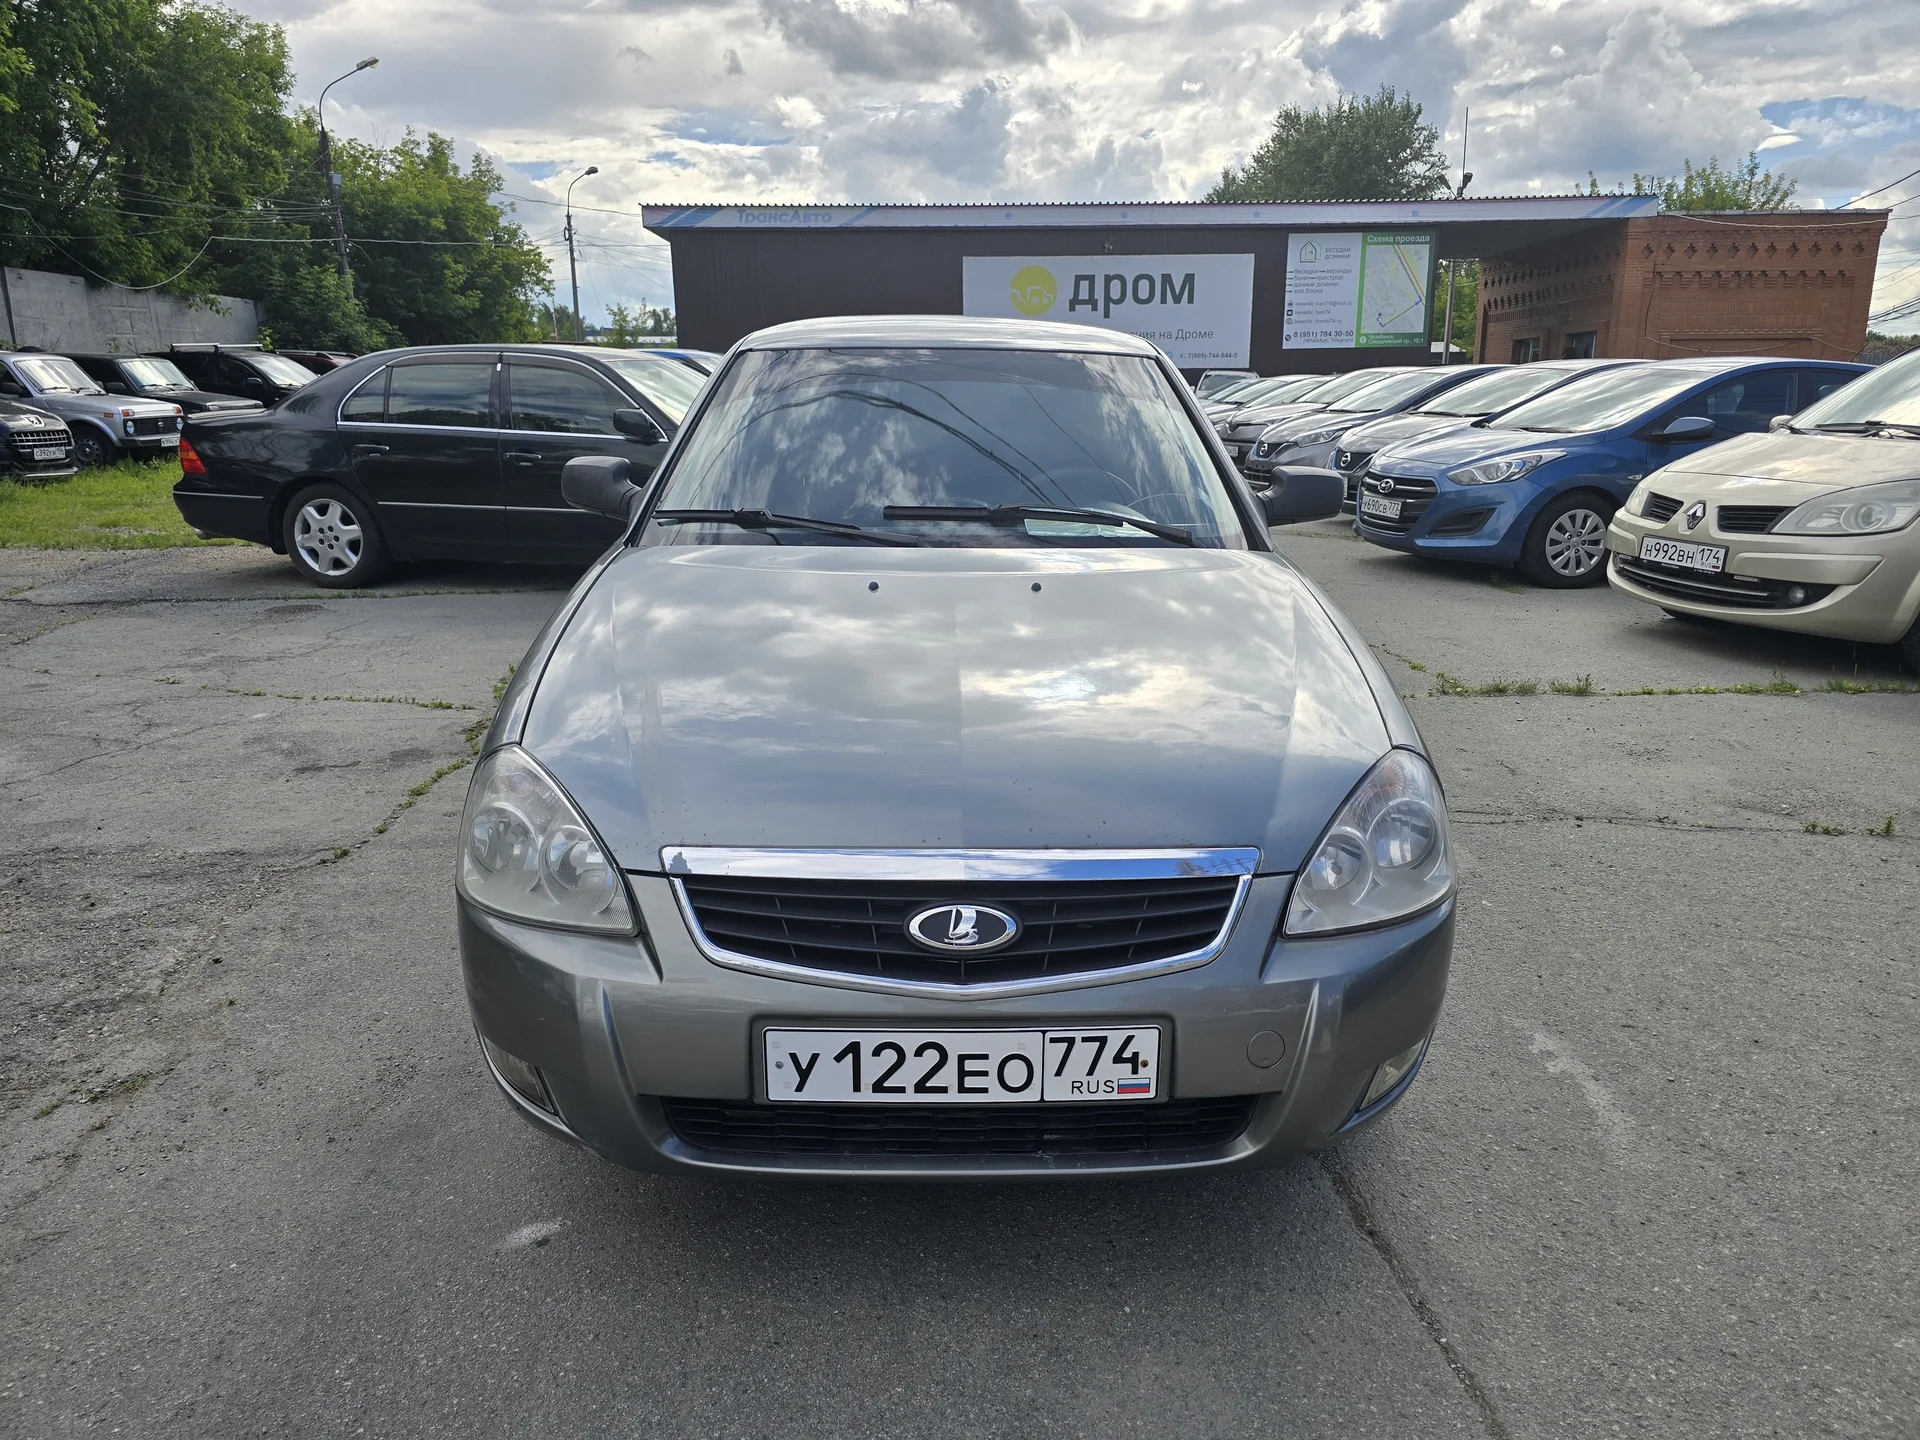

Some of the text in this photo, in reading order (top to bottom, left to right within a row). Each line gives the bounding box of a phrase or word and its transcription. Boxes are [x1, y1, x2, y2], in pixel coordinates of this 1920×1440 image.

[736, 209, 832, 224] ТрансАвто
[1367, 234, 1430, 243] Схема проезда
[1159, 331, 1172, 339] на
[1175, 328, 1214, 341] Дроме
[1699, 547, 1722, 564] 174
[1700, 561, 1712, 569] RUS
[1048, 1034, 1140, 1078] 774
[1071, 1079, 1115, 1095] RUS
